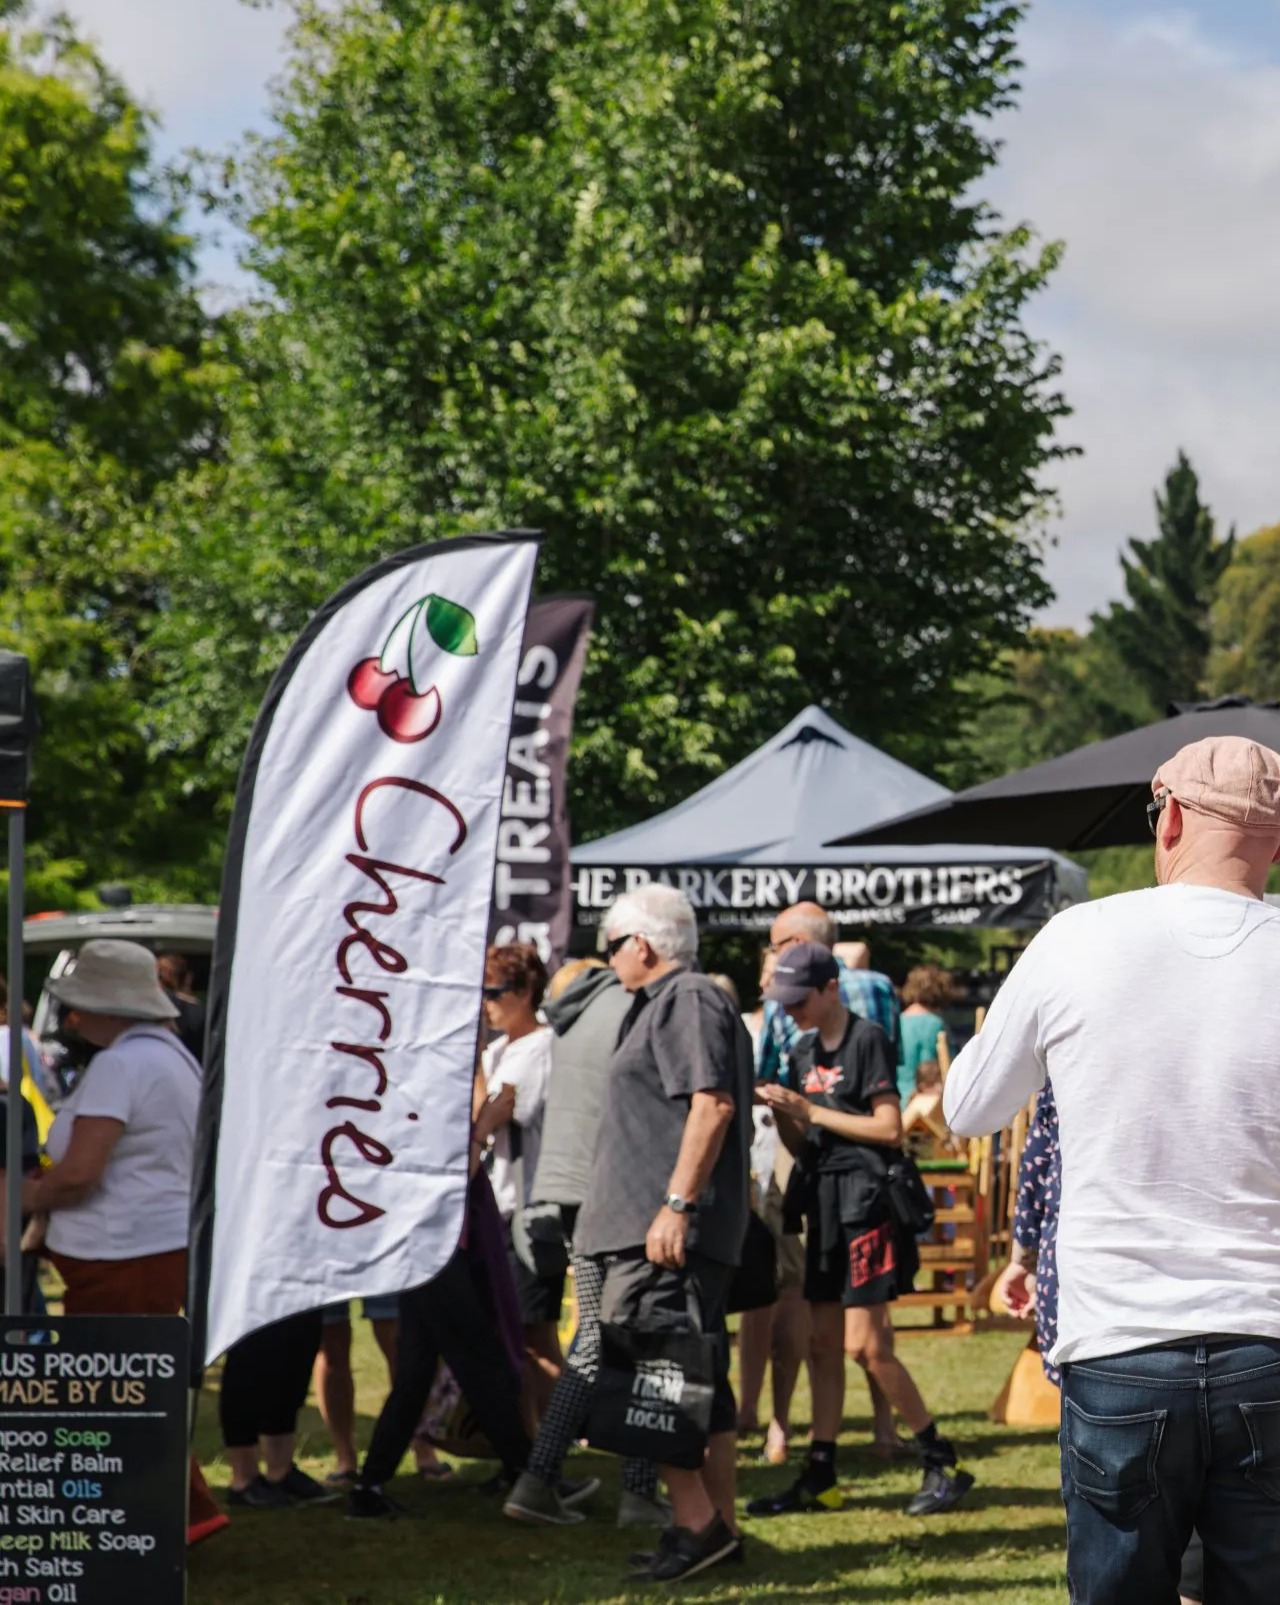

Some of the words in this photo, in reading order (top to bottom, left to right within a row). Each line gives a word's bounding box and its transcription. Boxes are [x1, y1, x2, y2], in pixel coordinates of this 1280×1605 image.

[814, 867, 1024, 907] BROTHERS
[317, 775, 468, 1230] Cherries
[0, 1353, 36, 1378] US
[44, 1353, 176, 1378] PRODUCTS
[68, 1380, 102, 1404] BY
[111, 1380, 146, 1405] US
[625, 1407, 677, 1434] LOCAL
[54, 1427, 111, 1451] Soap
[0, 1452, 64, 1473] Relief
[71, 1452, 123, 1473] Balm
[61, 1479, 103, 1499] Oils
[17, 1504, 65, 1525] Skin
[72, 1505, 126, 1525] Care
[50, 1530, 92, 1551] Milk
[98, 1531, 156, 1556] Soap
[25, 1556, 84, 1577] Salts
[47, 1583, 77, 1603] Oil
